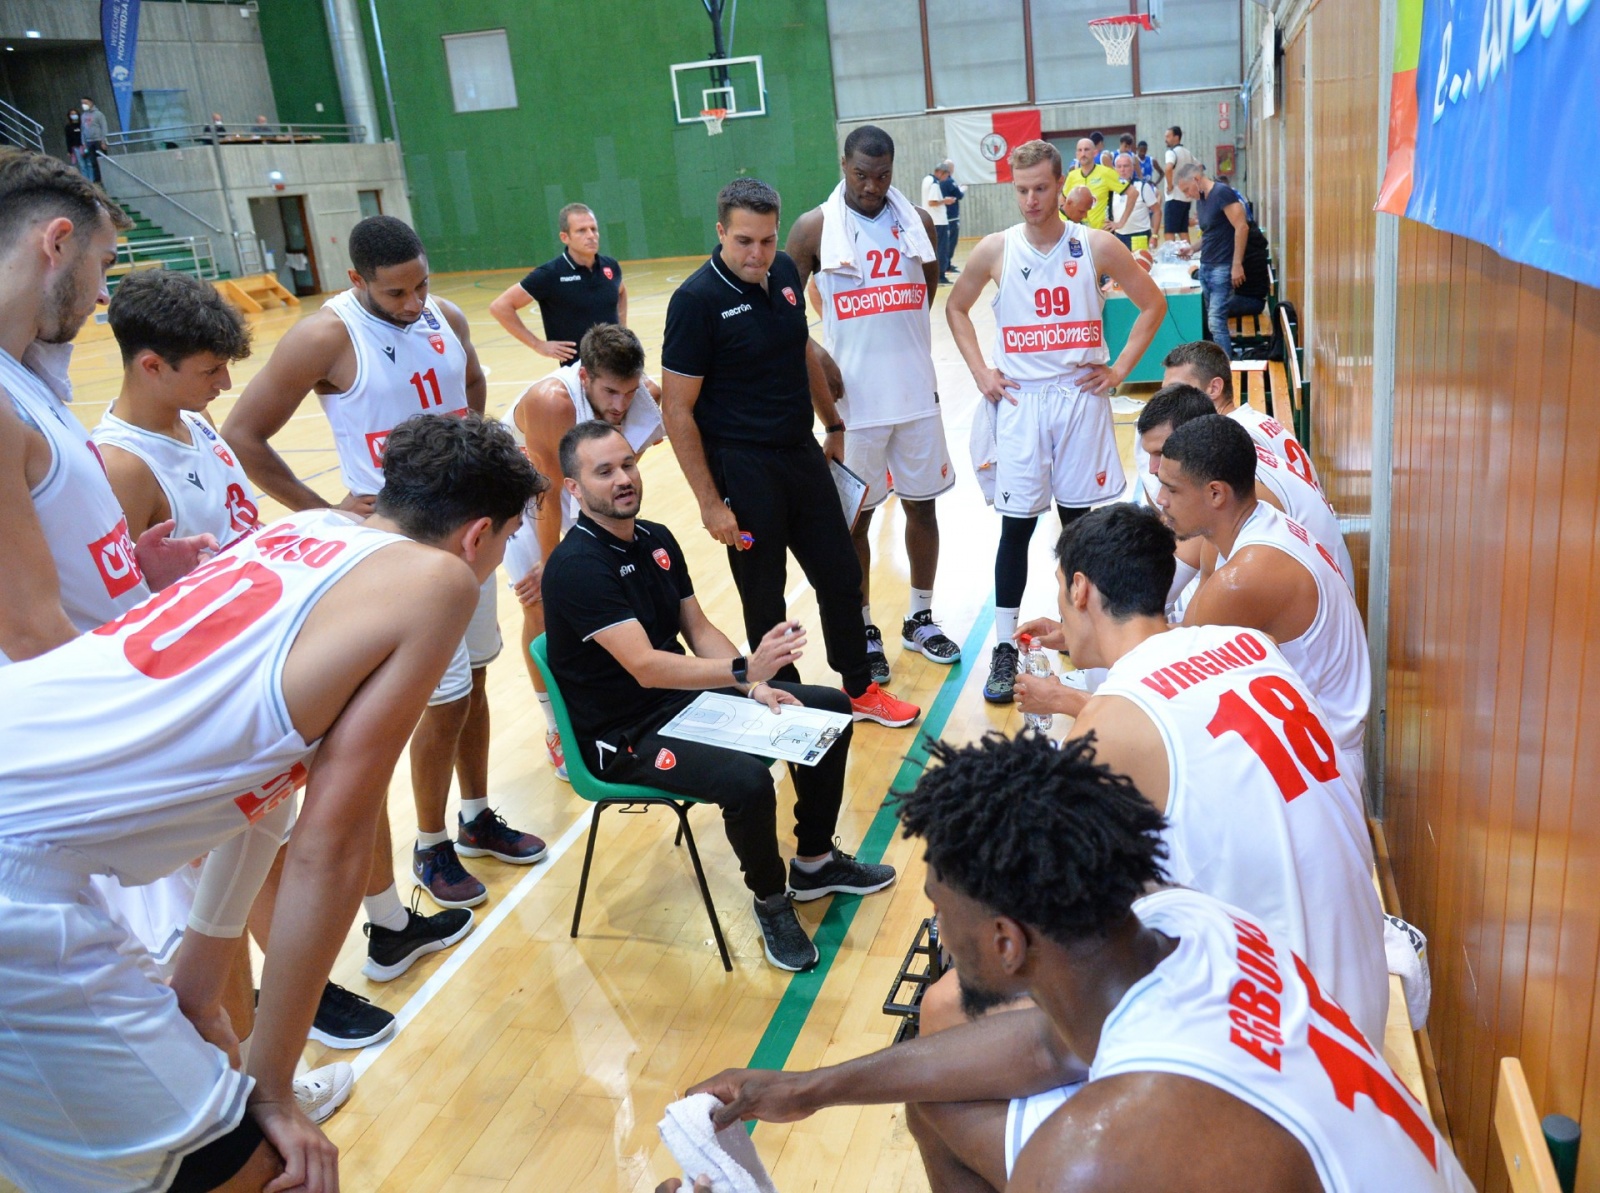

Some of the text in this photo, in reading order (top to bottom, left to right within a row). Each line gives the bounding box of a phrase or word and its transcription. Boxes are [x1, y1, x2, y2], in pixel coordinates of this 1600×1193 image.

[111, 4, 120, 46] WELCOME
[118, 3, 129, 61] MONTEROSA
[866, 247, 902, 279] 22
[721, 304, 752, 319] macron
[1034, 286, 1071, 317] 99
[409, 367, 443, 410] 11
[225, 483, 258, 532] 13
[1140, 632, 1267, 700] VIRGINIO
[1205, 675, 1341, 803] 18
